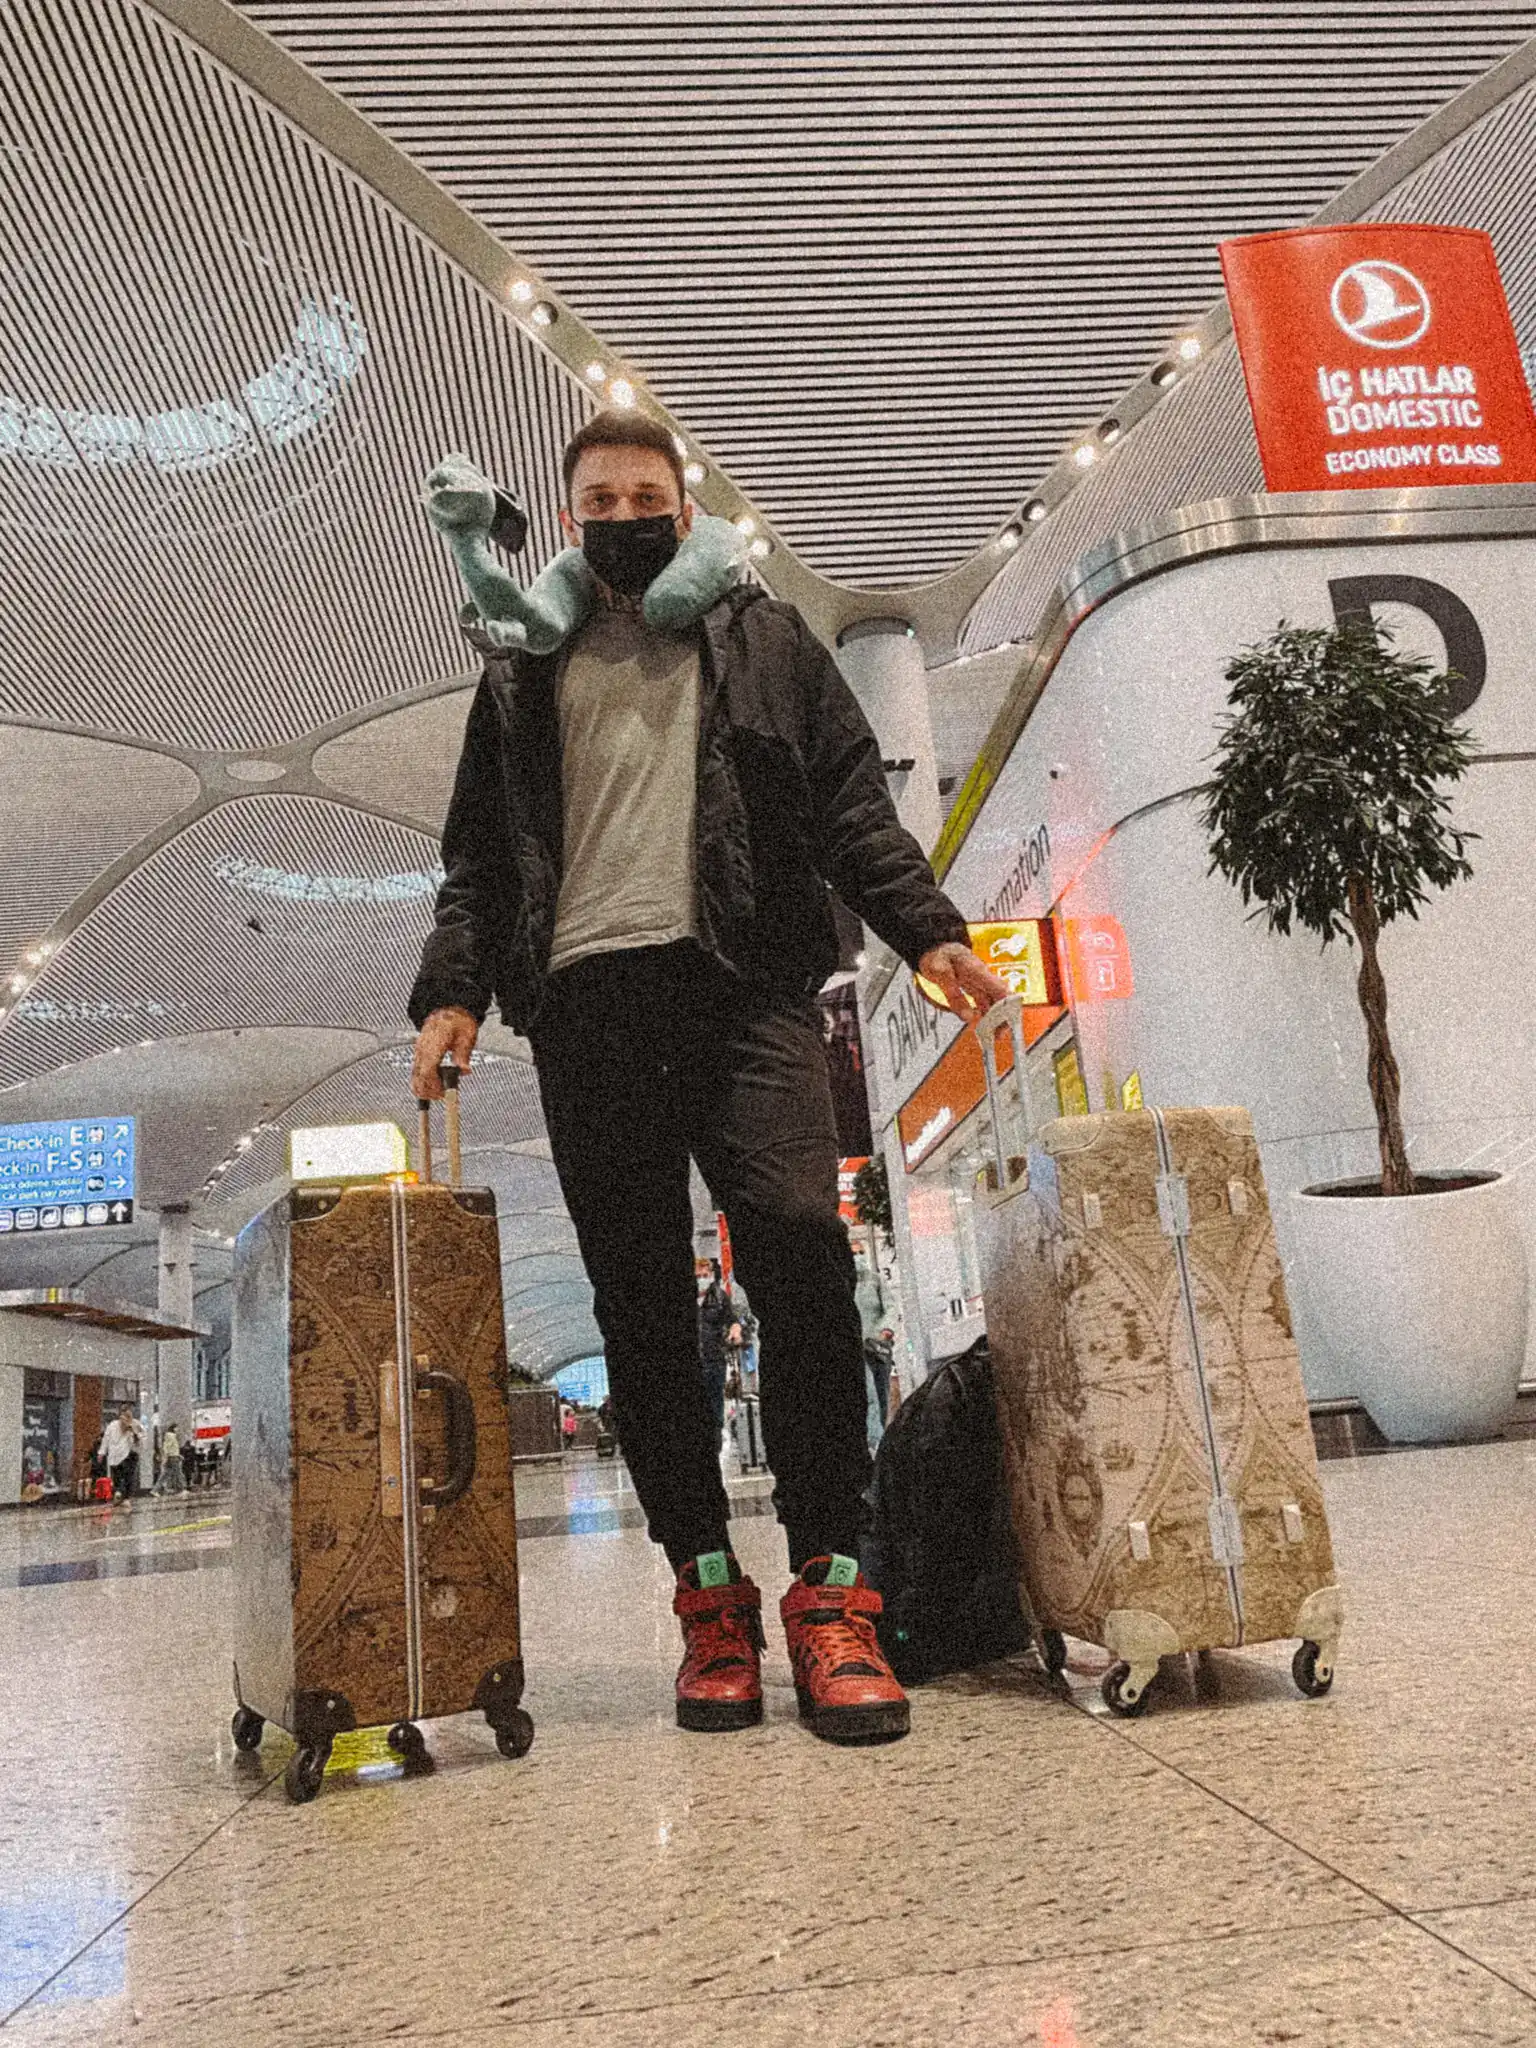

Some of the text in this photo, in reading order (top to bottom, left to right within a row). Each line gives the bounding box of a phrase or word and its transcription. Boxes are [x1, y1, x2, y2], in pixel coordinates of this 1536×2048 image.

[1359, 365, 1477, 397] HATLAR
[1326, 399, 1483, 435] DOMESTIC
[1325, 444, 1502, 474] ECONOMY CLASS
[70, 1126, 84, 1147] E
[0, 1149, 83, 1177] ck-in F-S
